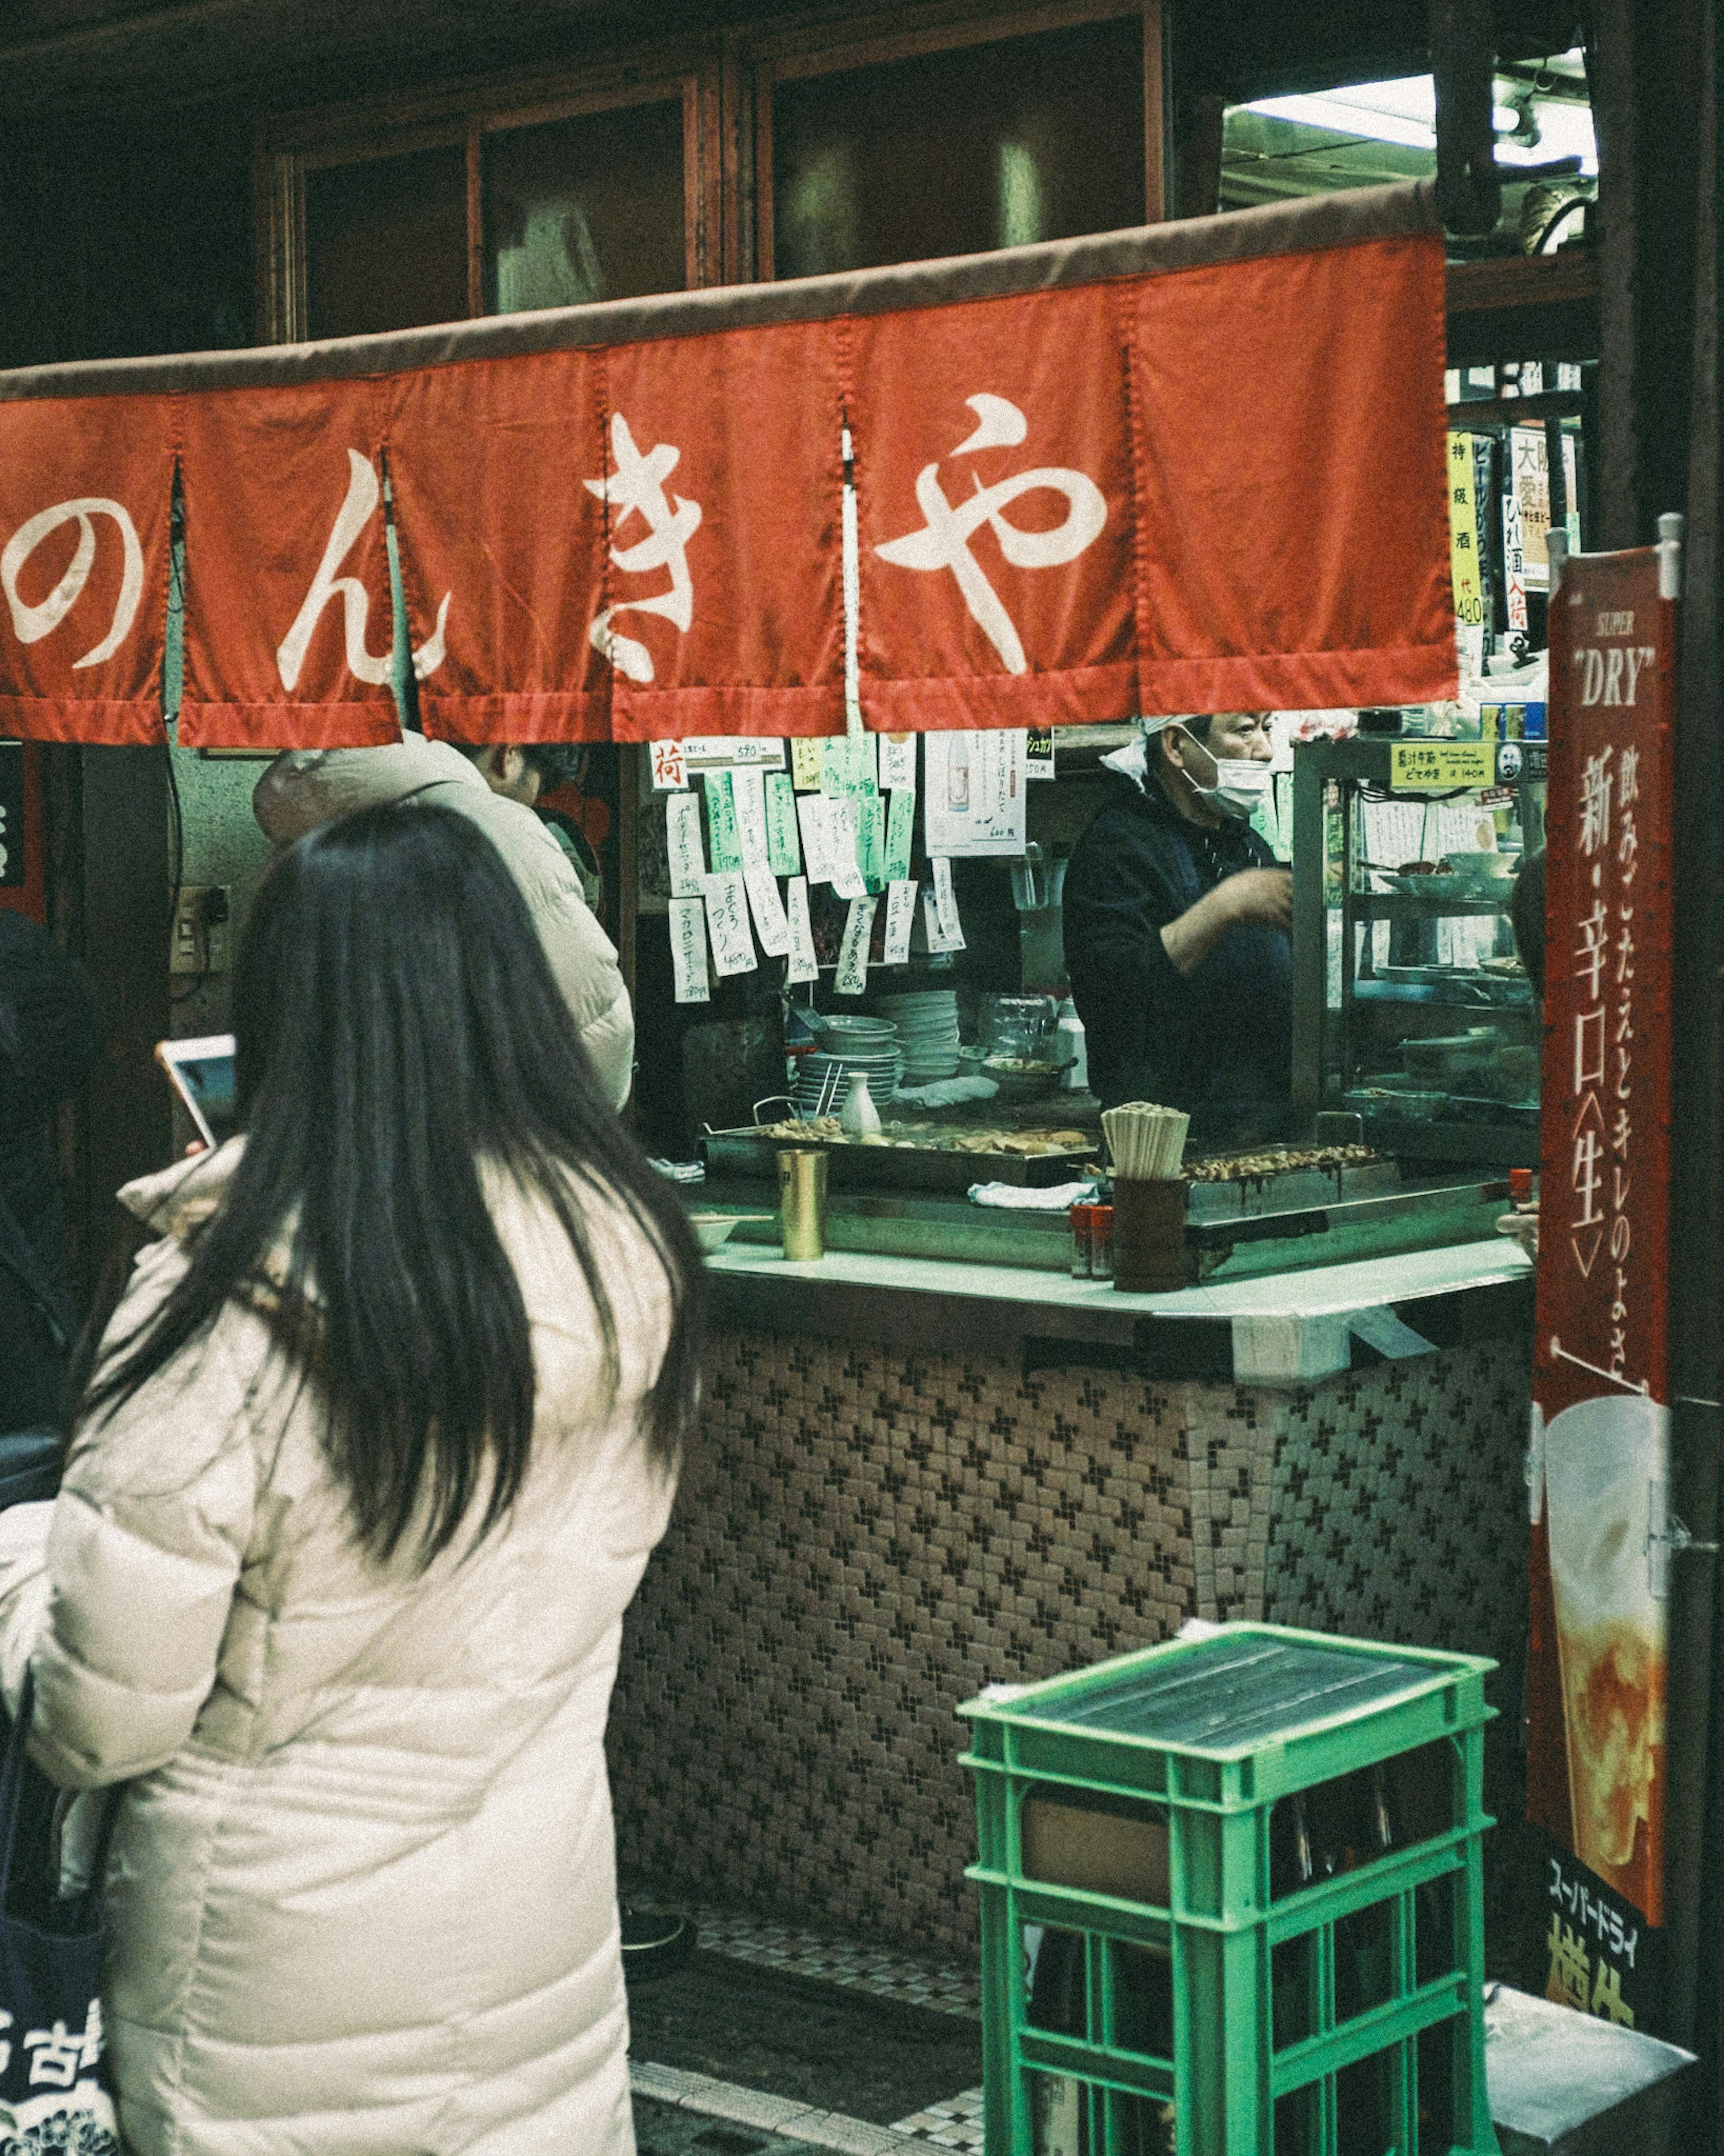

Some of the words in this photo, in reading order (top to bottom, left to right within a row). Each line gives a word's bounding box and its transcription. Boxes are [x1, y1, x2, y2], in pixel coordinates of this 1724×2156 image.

[1457, 597, 1482, 623] 480
[1594, 610, 1635, 638] SUPER
[1549, 1858, 1638, 1970] スーパードライ
